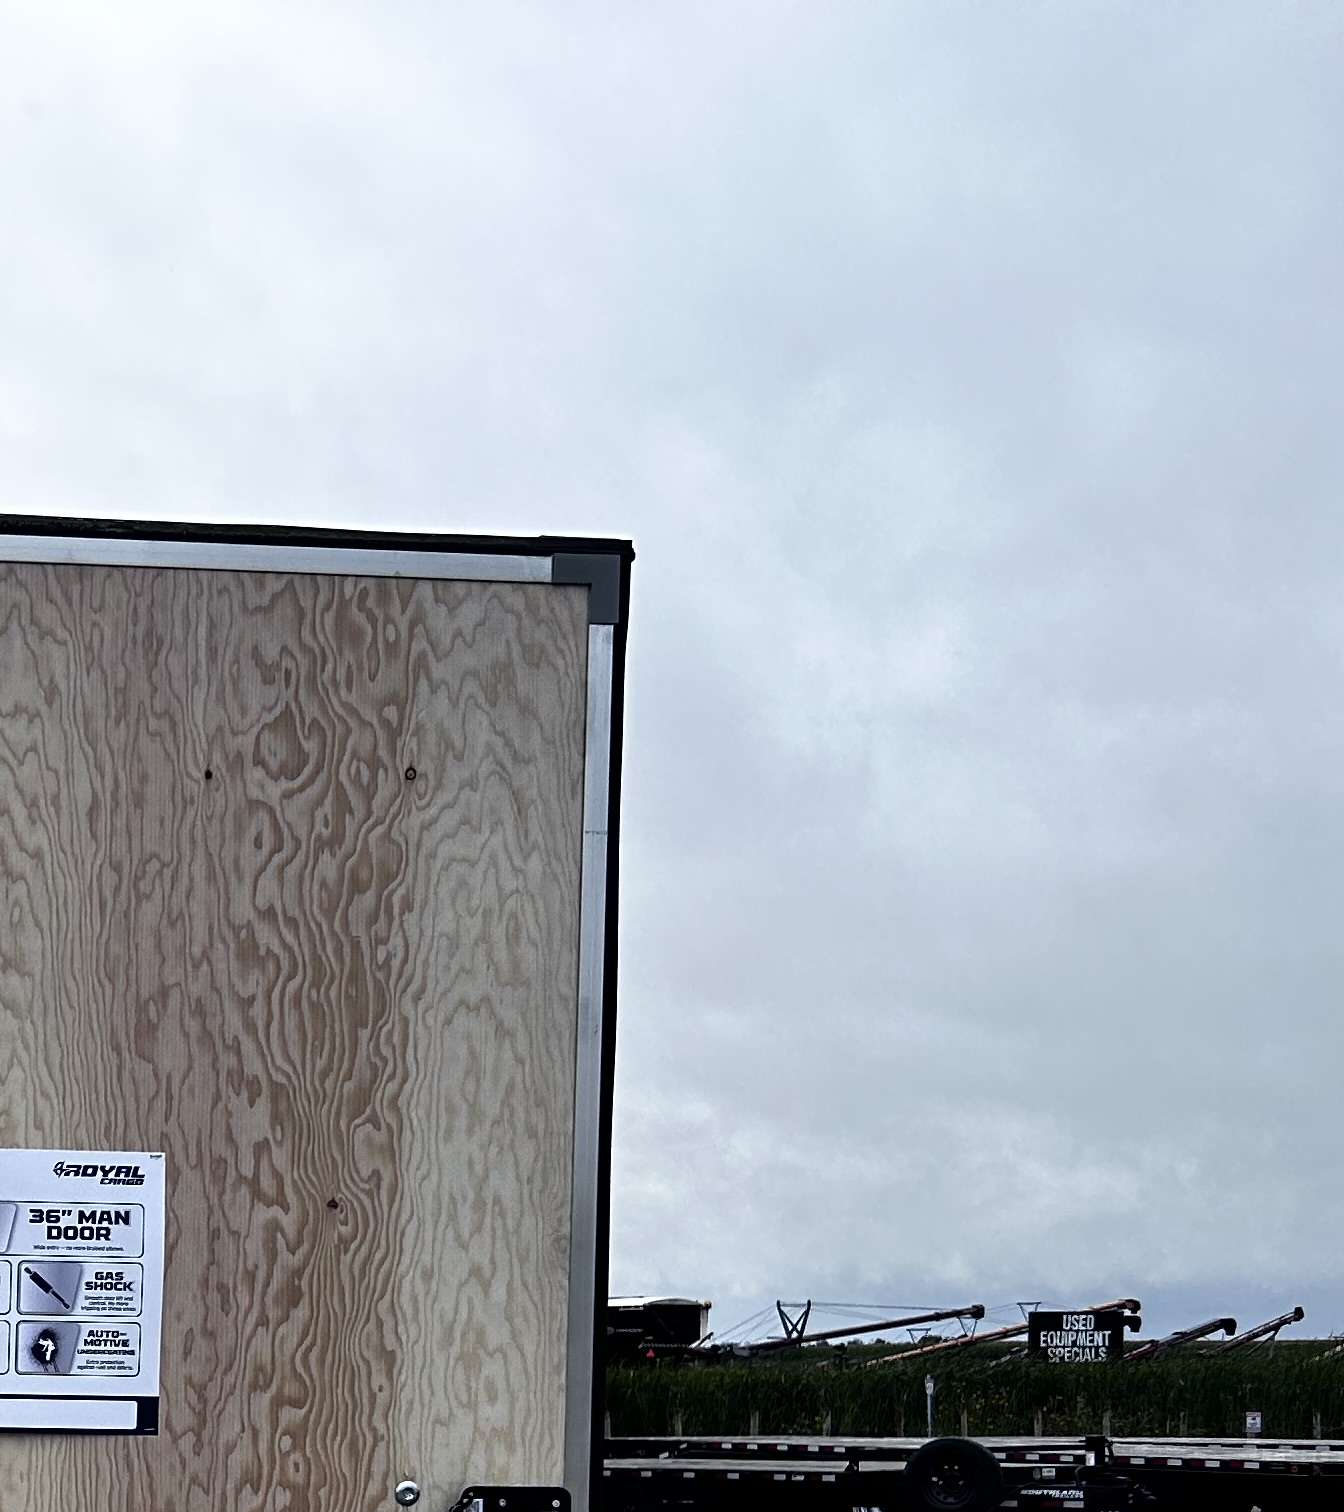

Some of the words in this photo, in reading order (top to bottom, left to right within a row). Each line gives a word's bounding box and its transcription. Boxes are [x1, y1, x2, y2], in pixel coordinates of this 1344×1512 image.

[63, 1164, 146, 1179] ROYAL
[77, 1209, 131, 1226] MAN
[46, 1225, 112, 1241] DOOR
[94, 1271, 124, 1281] GAS
[84, 1281, 134, 1292] SHOCK
[1062, 1314, 1095, 1331] USED
[83, 1338, 130, 1348] MOTIVE
[1039, 1330, 1112, 1347] EQUIPMENT
[1047, 1346, 1108, 1363] SPECIALS
